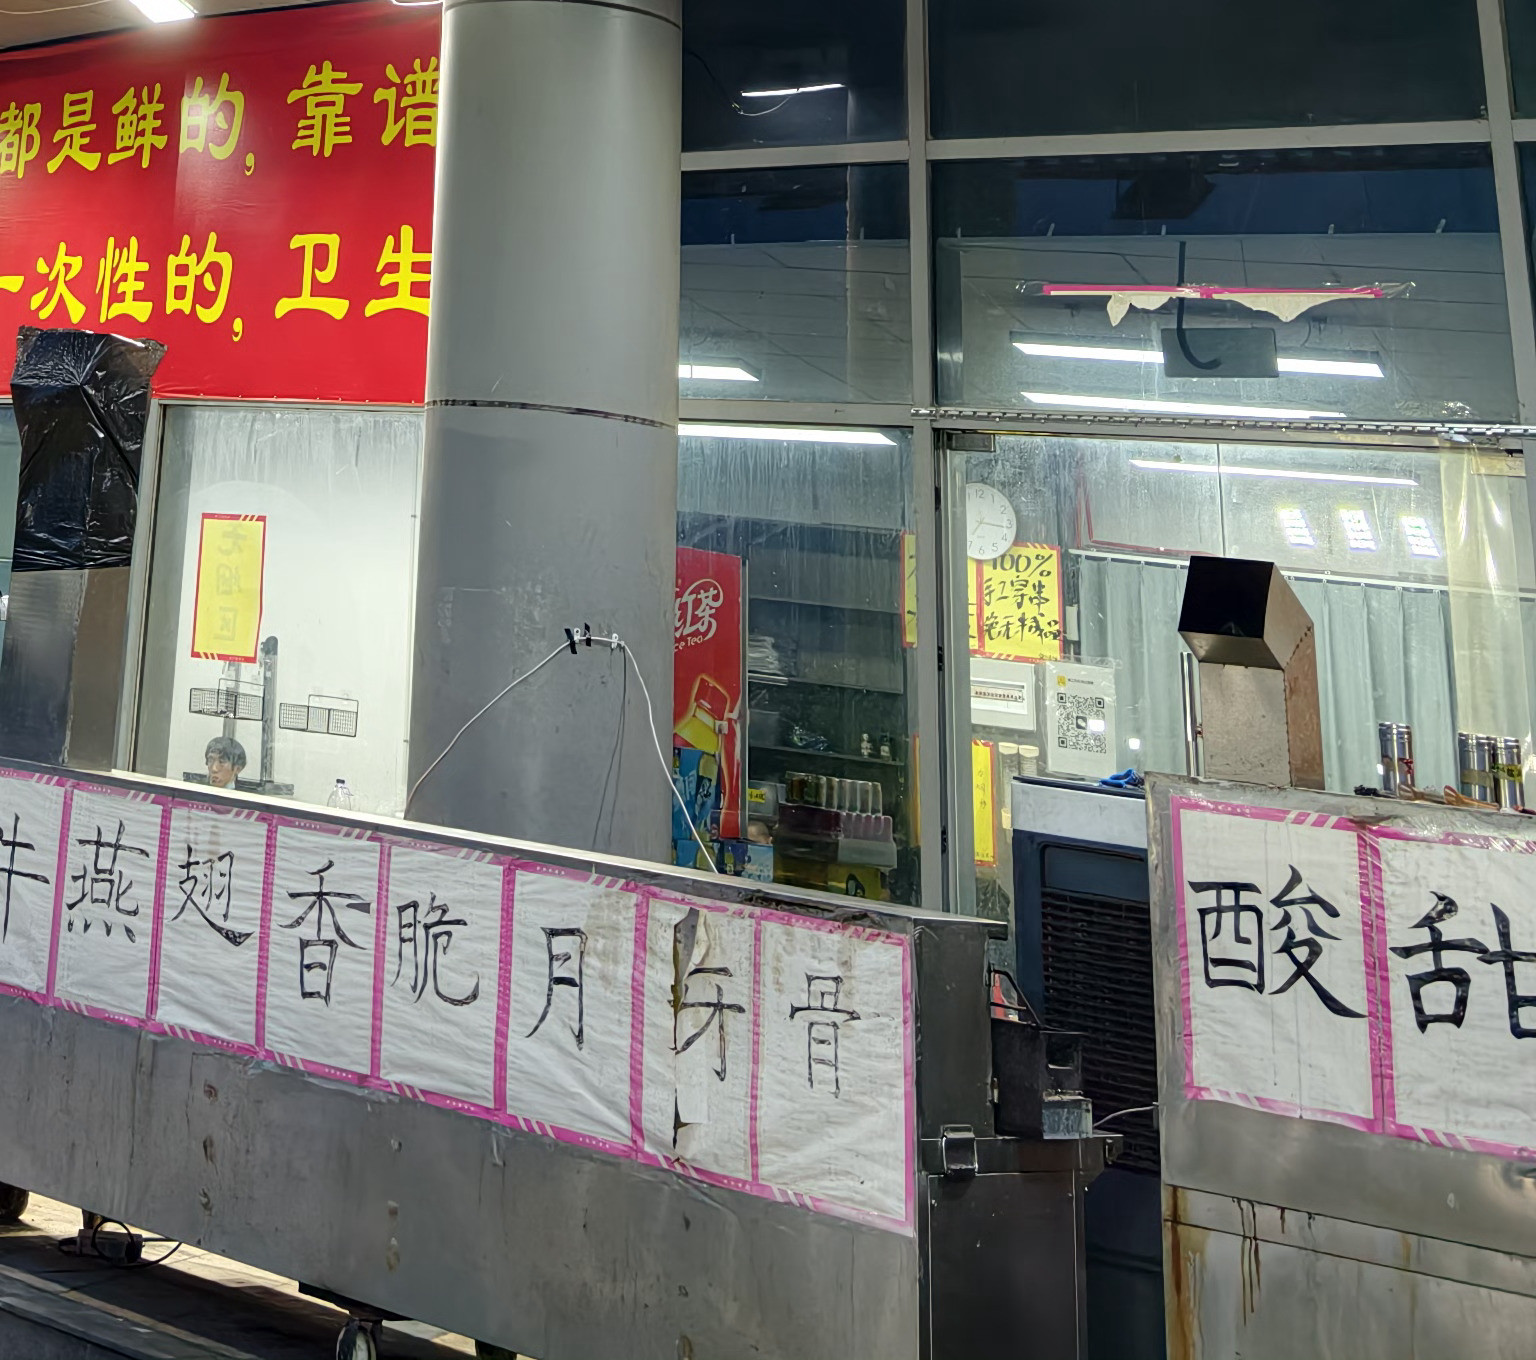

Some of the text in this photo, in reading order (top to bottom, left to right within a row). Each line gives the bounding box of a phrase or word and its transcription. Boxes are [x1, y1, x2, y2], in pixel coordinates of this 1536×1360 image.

[975, 488, 985, 499] 12
[991, 494, 995, 503] 1
[1000, 504, 1007, 515] 2
[1006, 519, 1013, 529] 3
[1001, 532, 1008, 542] 4
[968, 540, 973, 550] 7
[991, 542, 999, 552] 5
[978, 546, 985, 556] 6
[687, 635, 703, 647] Tea
